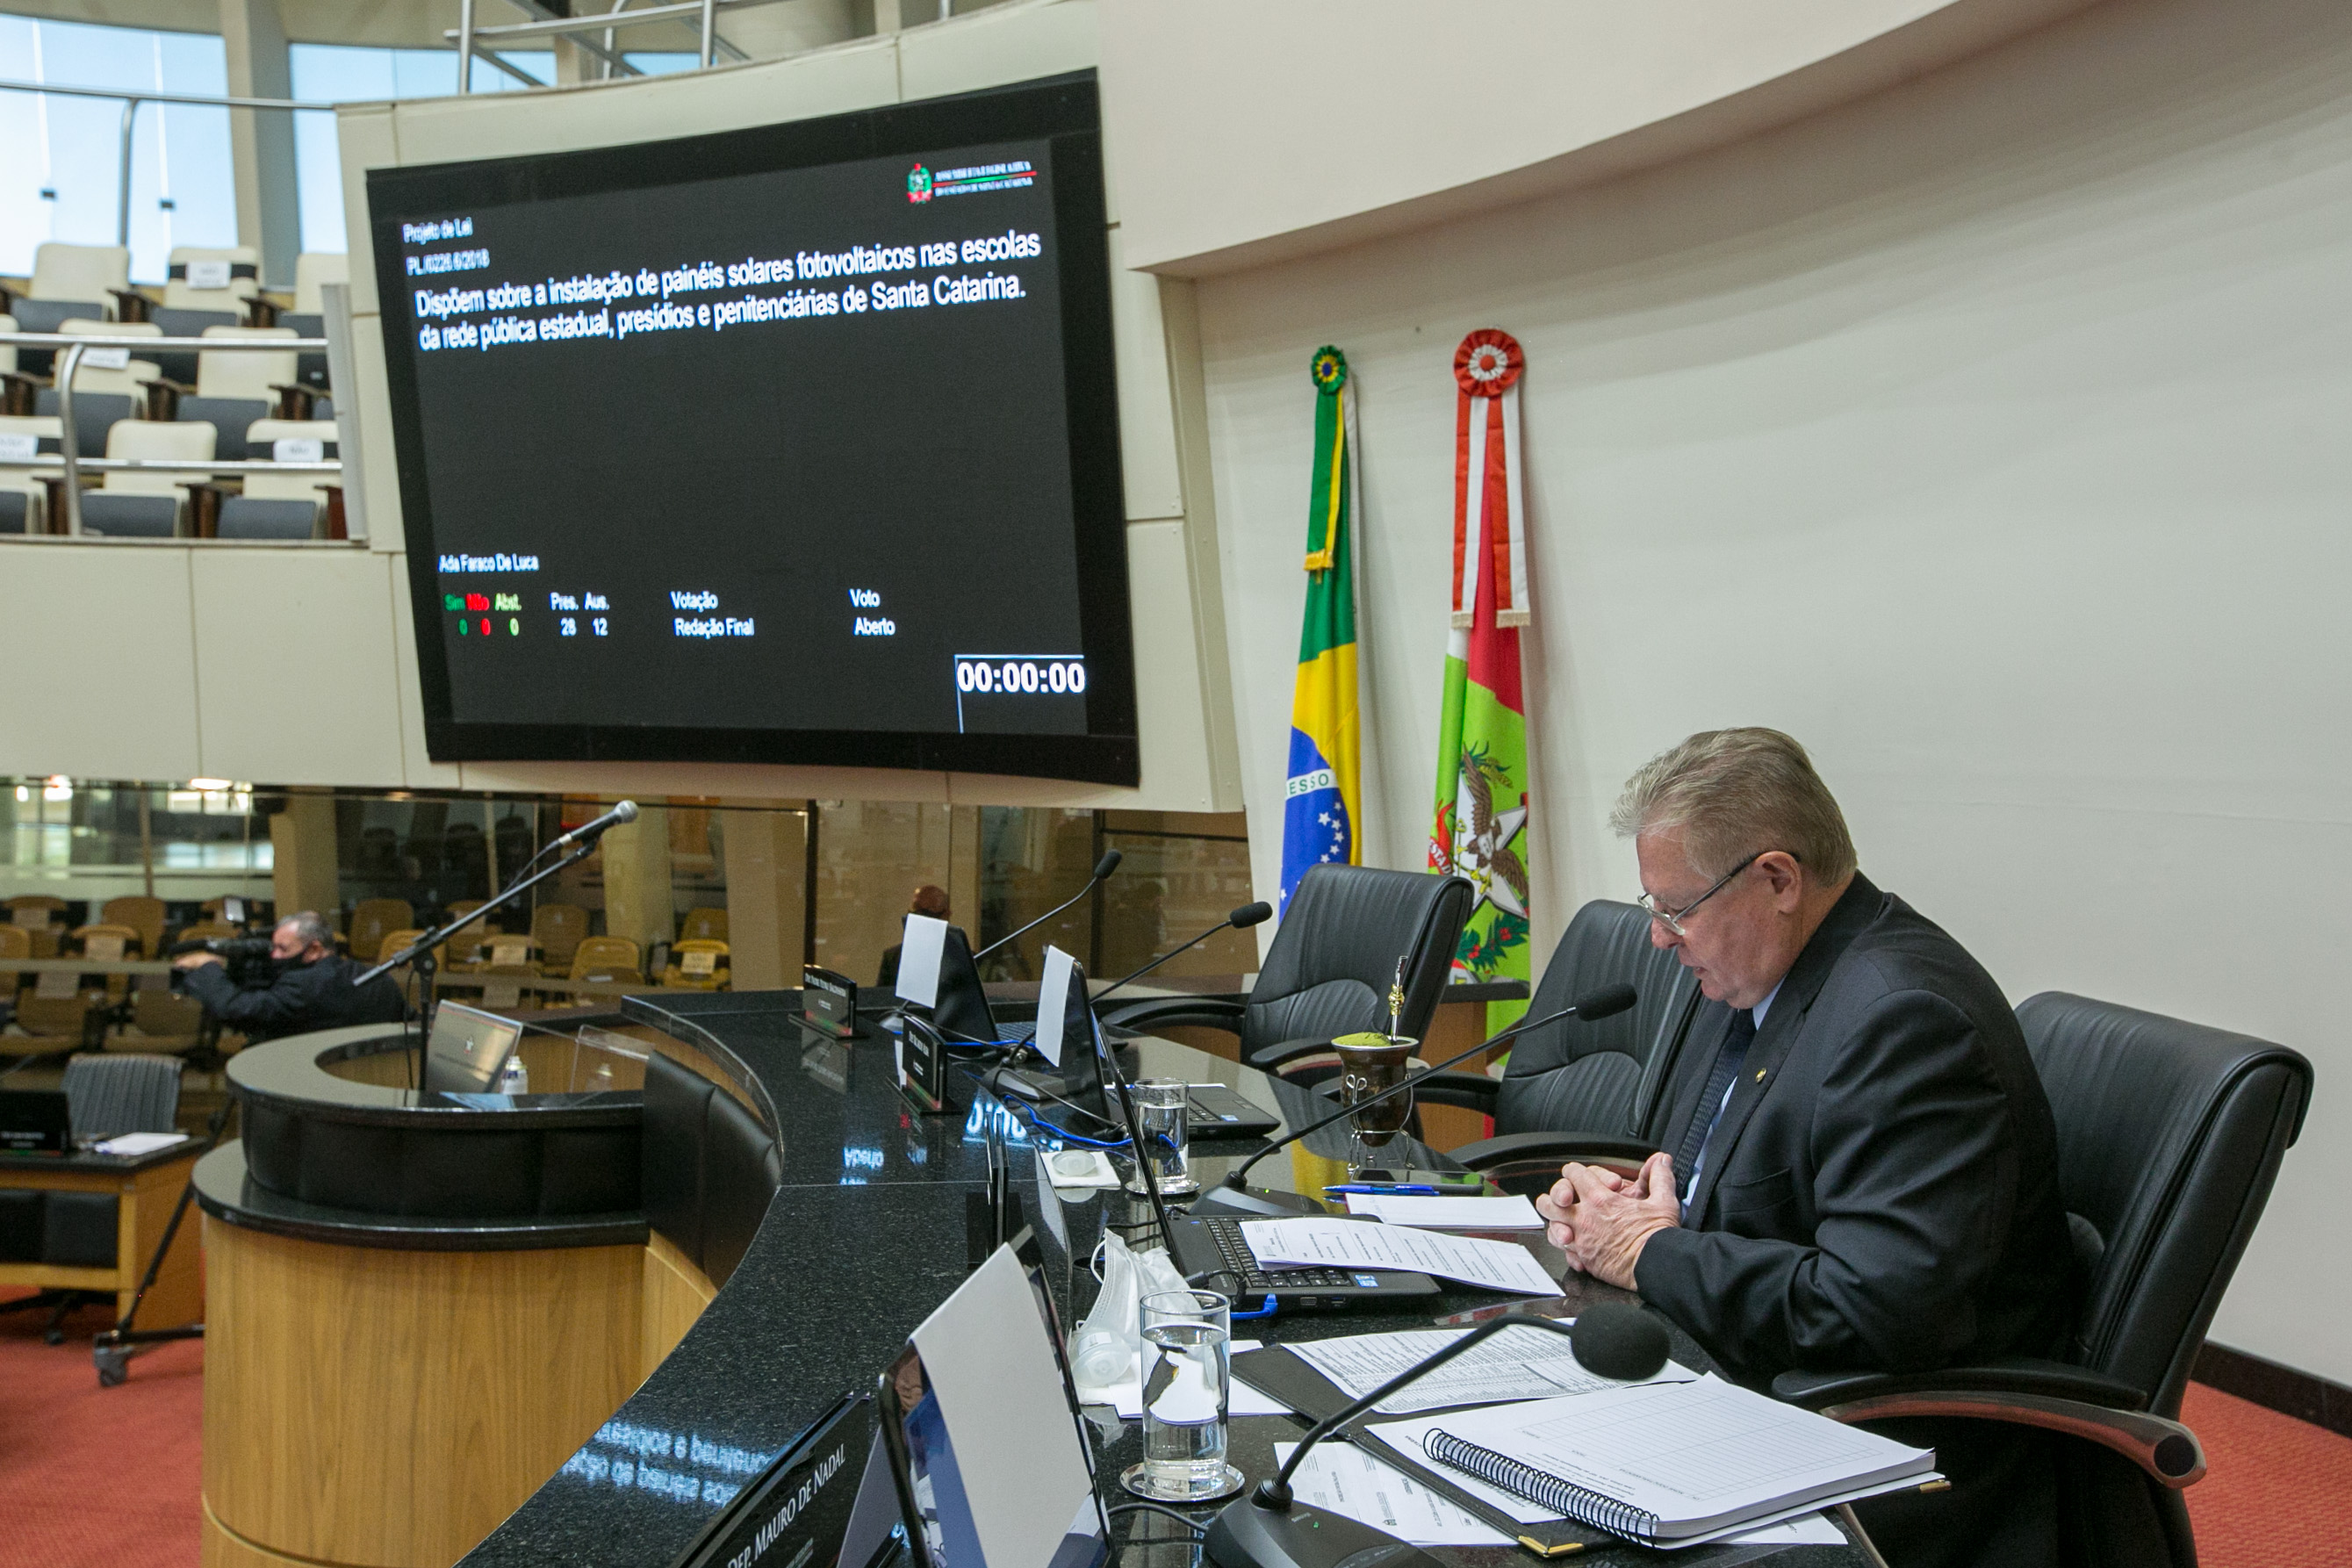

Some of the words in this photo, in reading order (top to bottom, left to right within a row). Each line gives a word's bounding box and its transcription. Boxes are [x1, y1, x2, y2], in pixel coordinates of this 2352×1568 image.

[403, 223, 439, 245] Projeto
[440, 219, 455, 239] de
[454, 217, 472, 237] Lei
[415, 286, 484, 320] Dispõem
[486, 282, 532, 311] sobre
[535, 284, 546, 306] a
[548, 270, 633, 305] instalação
[636, 268, 658, 296] de
[661, 261, 724, 299] painéis
[728, 257, 793, 287] solares
[796, 243, 915, 279] fotovoltaicos
[920, 241, 957, 267] nas
[961, 229, 1041, 263] escolas
[419, 324, 441, 351] da
[442, 321, 478, 349] rede
[480, 316, 537, 351] pública
[539, 308, 614, 341] estadual,
[616, 302, 694, 340] presídios
[697, 305, 710, 326] e
[714, 289, 838, 331] penitenciárias
[842, 284, 867, 313] de
[871, 279, 929, 311] Santa
[933, 271, 1026, 306] Catarina.
[439, 554, 460, 572] Ada
[460, 554, 495, 572] Faraco
[495, 553, 511, 572] De
[512, 553, 539, 571] Luca
[550, 592, 579, 610] Pres.
[584, 591, 609, 610] Aus.
[671, 591, 718, 612] Votação
[849, 589, 881, 608] Voto
[509, 618, 520, 636] 0
[593, 617, 608, 637] 12
[674, 618, 725, 639] Redação
[726, 618, 754, 637] Final
[854, 617, 896, 636] Aberto
[957, 662, 1086, 693] 00:00:00
[755, 1498, 795, 1561] MAURO
[798, 1478, 812, 1512] DE
[814, 1443, 846, 1494] NADAL
